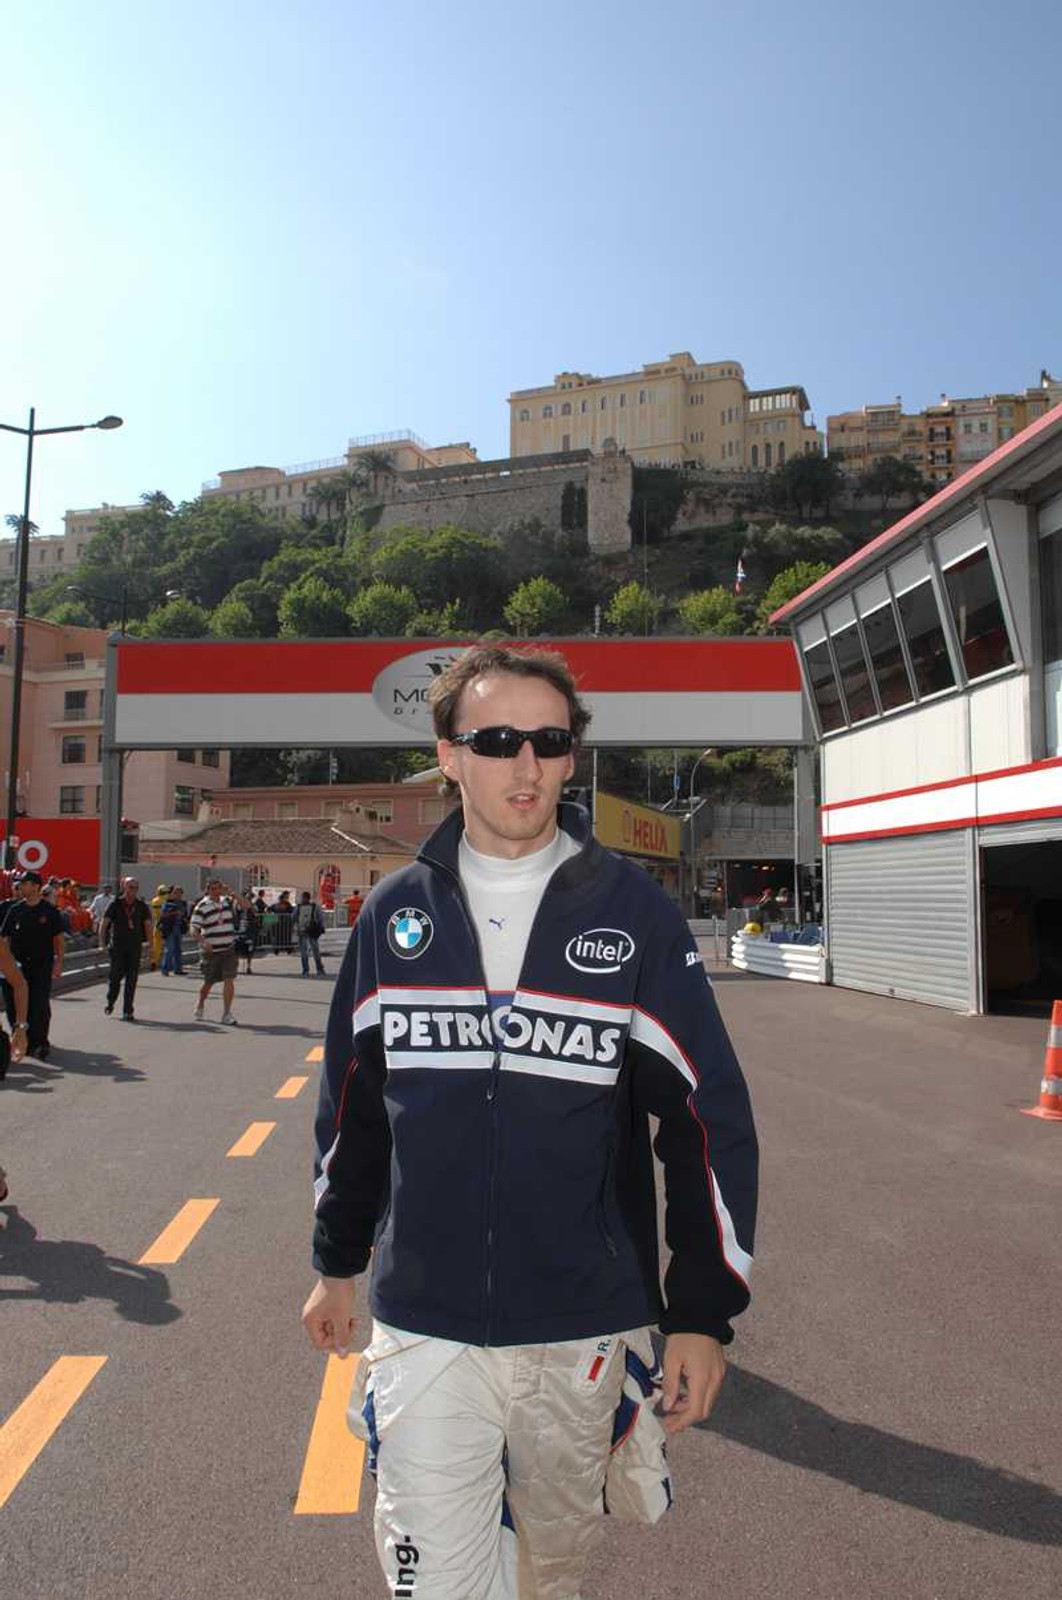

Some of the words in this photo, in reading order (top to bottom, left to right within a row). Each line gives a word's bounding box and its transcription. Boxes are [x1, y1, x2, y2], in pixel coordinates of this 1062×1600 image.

[633, 817, 668, 853] HELIX
[390, 909, 430, 926] BMW
[575, 935, 624, 962] intel
